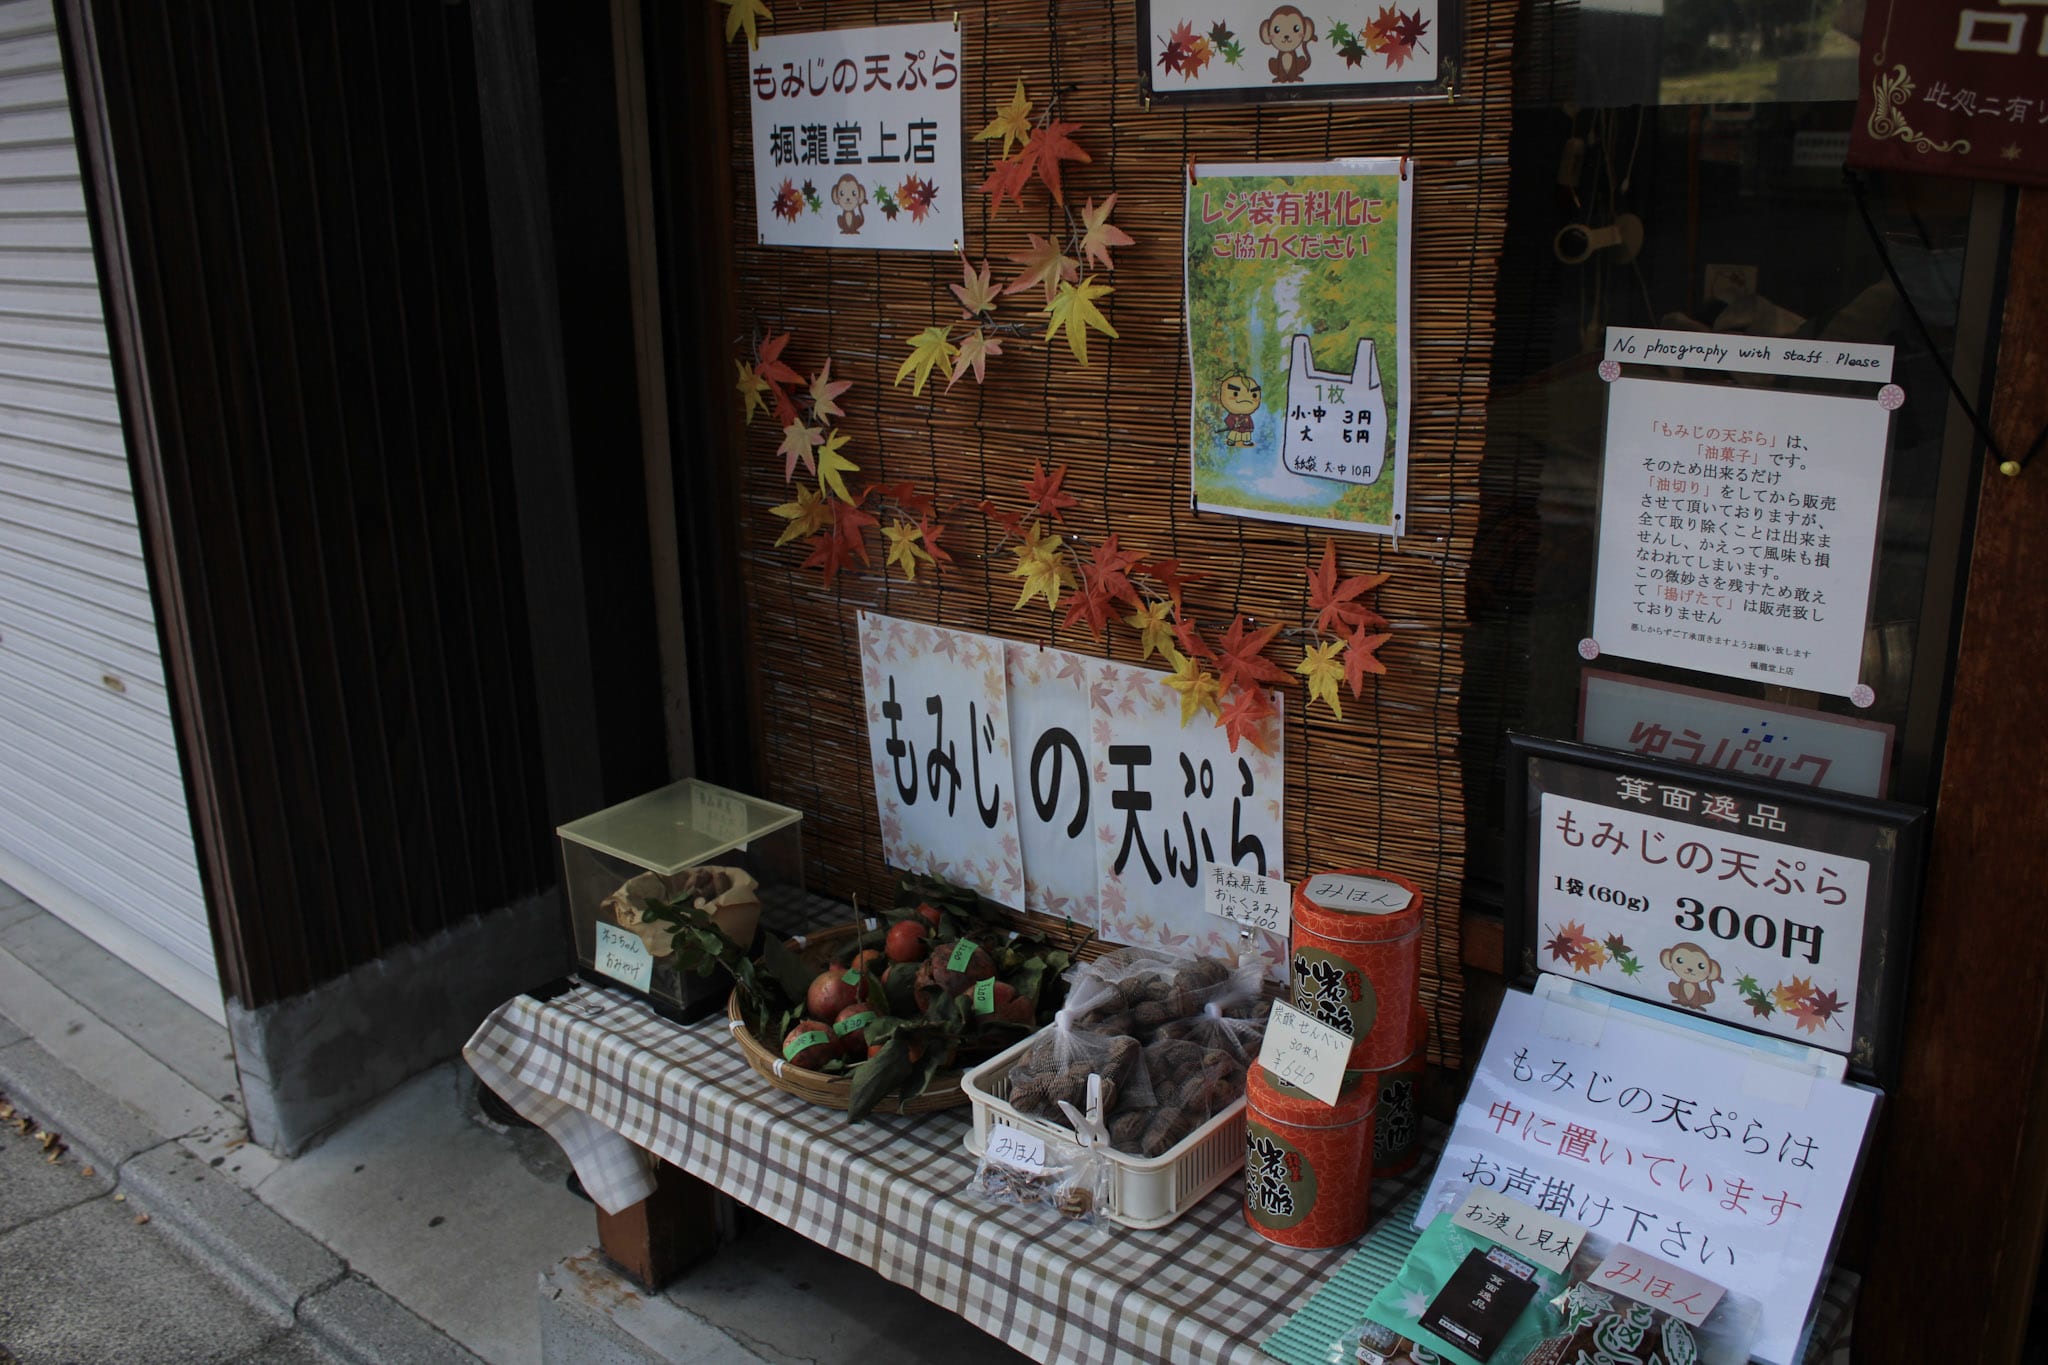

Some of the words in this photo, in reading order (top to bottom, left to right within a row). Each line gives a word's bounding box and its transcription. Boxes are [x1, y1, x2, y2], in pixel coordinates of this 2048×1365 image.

[753, 49, 958, 101] もみじの天ぷら
[1201, 190, 1383, 226] レジ袋有料化に
[1212, 233, 1369, 260] ご協力ください
[1613, 336, 1636, 354] No
[1739, 344, 1770, 361] with
[1836, 353, 1880, 368] Please
[1314, 383, 1345, 405] 1枚
[1300, 425, 1313, 442] 大
[1343, 429, 1370, 444] 5円
[1342, 409, 1371, 425] 3円
[1351, 464, 1371, 478] 10円
[1642, 457, 1781, 485] そのため出来るだけ
[1640, 494, 1827, 529] させて頂いておりますが、
[1639, 512, 1832, 549] 全て取り除くことは出来ま
[1636, 548, 1783, 581] なわれてしまいます。
[1637, 529, 1831, 568] せんし、かえって風味も損
[1635, 565, 1827, 604] この微妙さを残すため敢え
[1634, 601, 1722, 625] ておりません
[882, 675, 1267, 888] もみじの天ぷら
[1616, 774, 1788, 833] 箕面逸品
[1555, 810, 1847, 907] もみじの天ぷら
[1212, 868, 1268, 896] 青森県産
[1316, 883, 1402, 908] みほん
[1215, 888, 1280, 919] おにくるみ
[1674, 896, 1825, 965] 300円
[1512, 1048, 1823, 1170] もみじの天ぷらは
[996, 1138, 1044, 1166] みほん
[1489, 1100, 1802, 1226] 中に置いています
[1463, 1153, 1736, 1267] お声掛け下さい
[1466, 1203, 1574, 1261] お渡し見本
[1604, 1259, 1707, 1316] みほん
